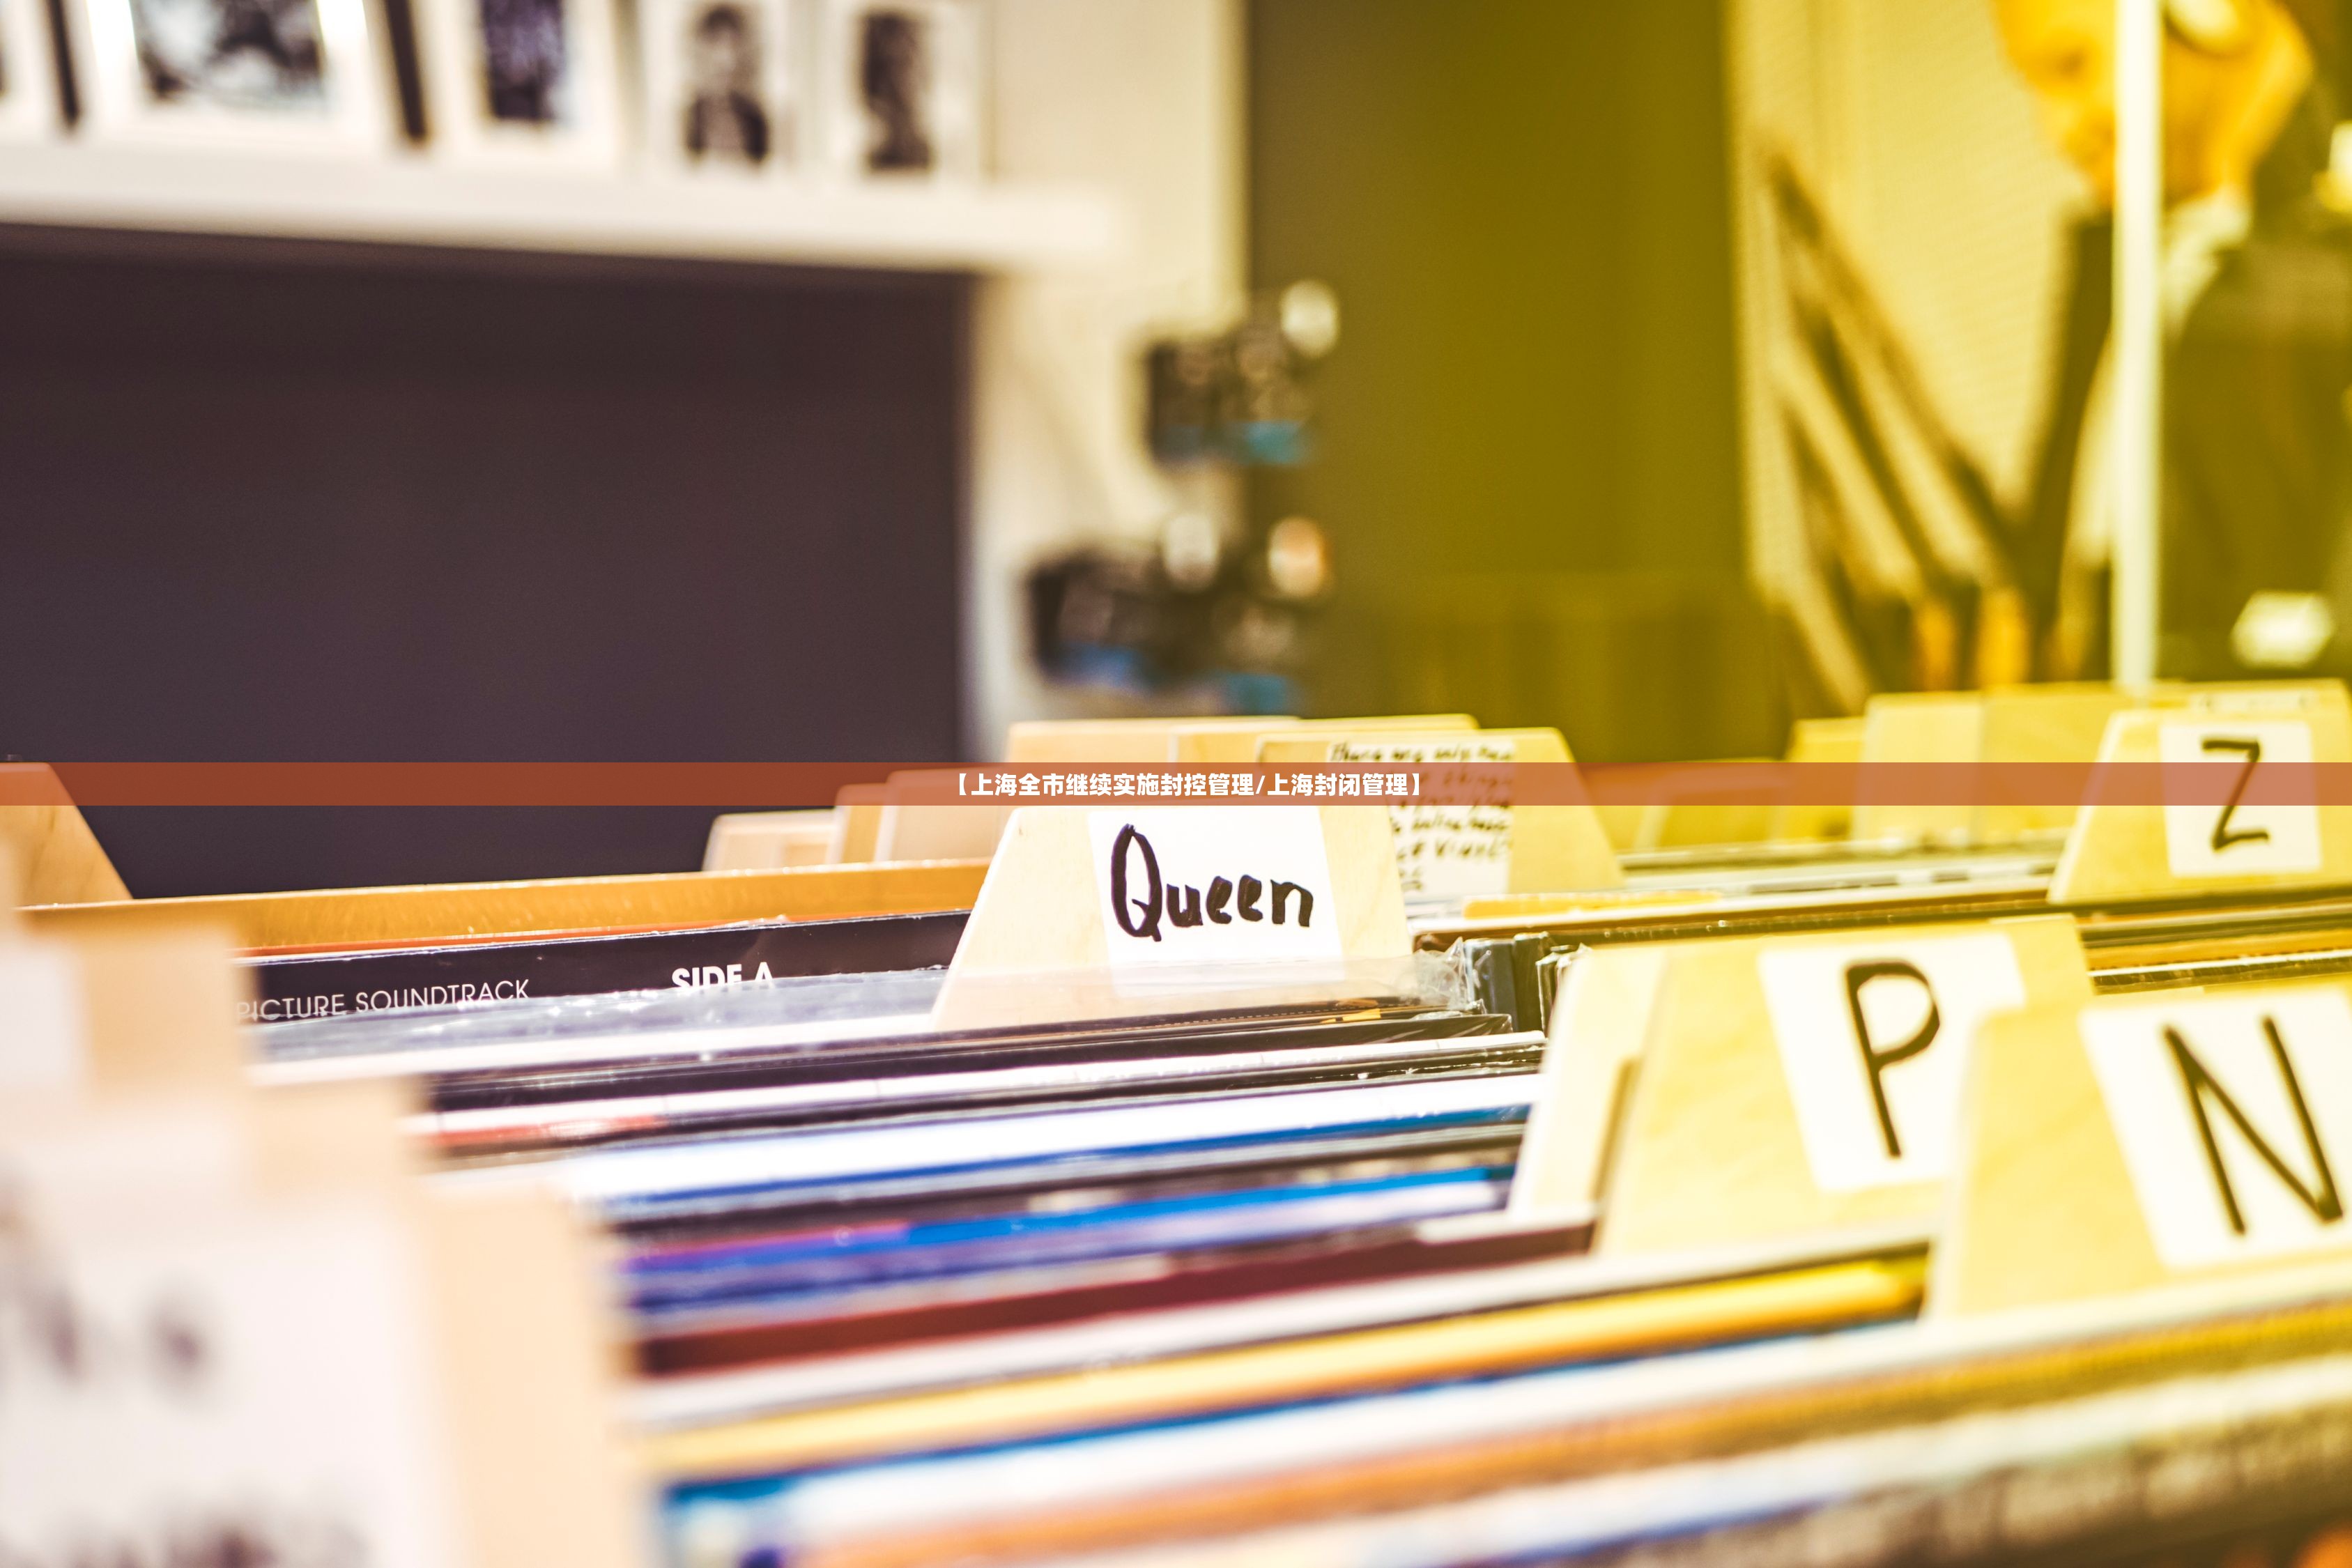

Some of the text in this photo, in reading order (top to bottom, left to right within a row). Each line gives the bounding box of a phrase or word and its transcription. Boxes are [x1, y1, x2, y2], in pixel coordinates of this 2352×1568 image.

[1110, 822, 1314, 942] Queen
[236, 978, 530, 1022] PICTURE SOUNDTRACK
[672, 961, 774, 987] SIDE A
[1845, 961, 1941, 1158] P
[2162, 1015, 2344, 1234] N
